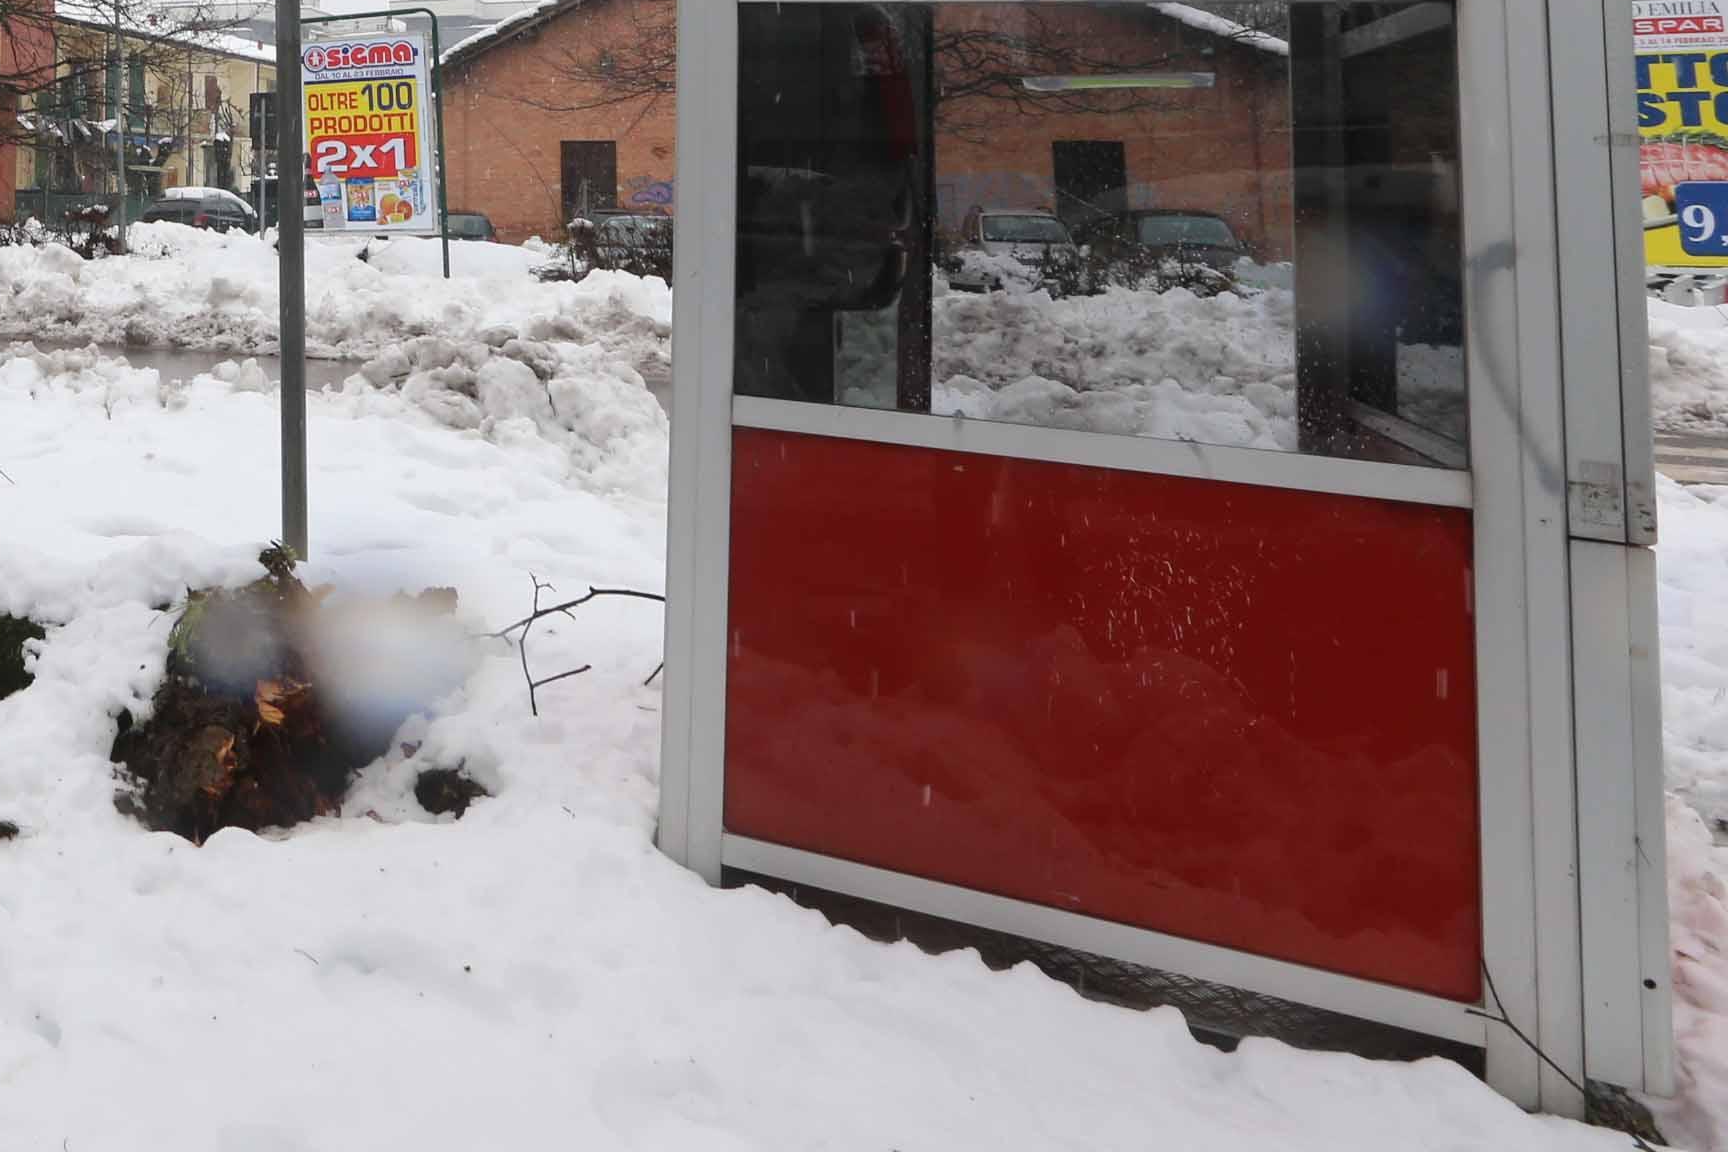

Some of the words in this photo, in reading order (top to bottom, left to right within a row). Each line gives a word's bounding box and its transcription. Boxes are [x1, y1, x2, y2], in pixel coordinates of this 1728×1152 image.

[1648, 0, 1720, 17] EMILIA
[1635, 18, 1722, 33] SPAR
[308, 91, 359, 111] OLTRE
[361, 81, 413, 112] 100
[309, 112, 414, 135] PRODOTTI
[316, 138, 405, 173] 2x1
